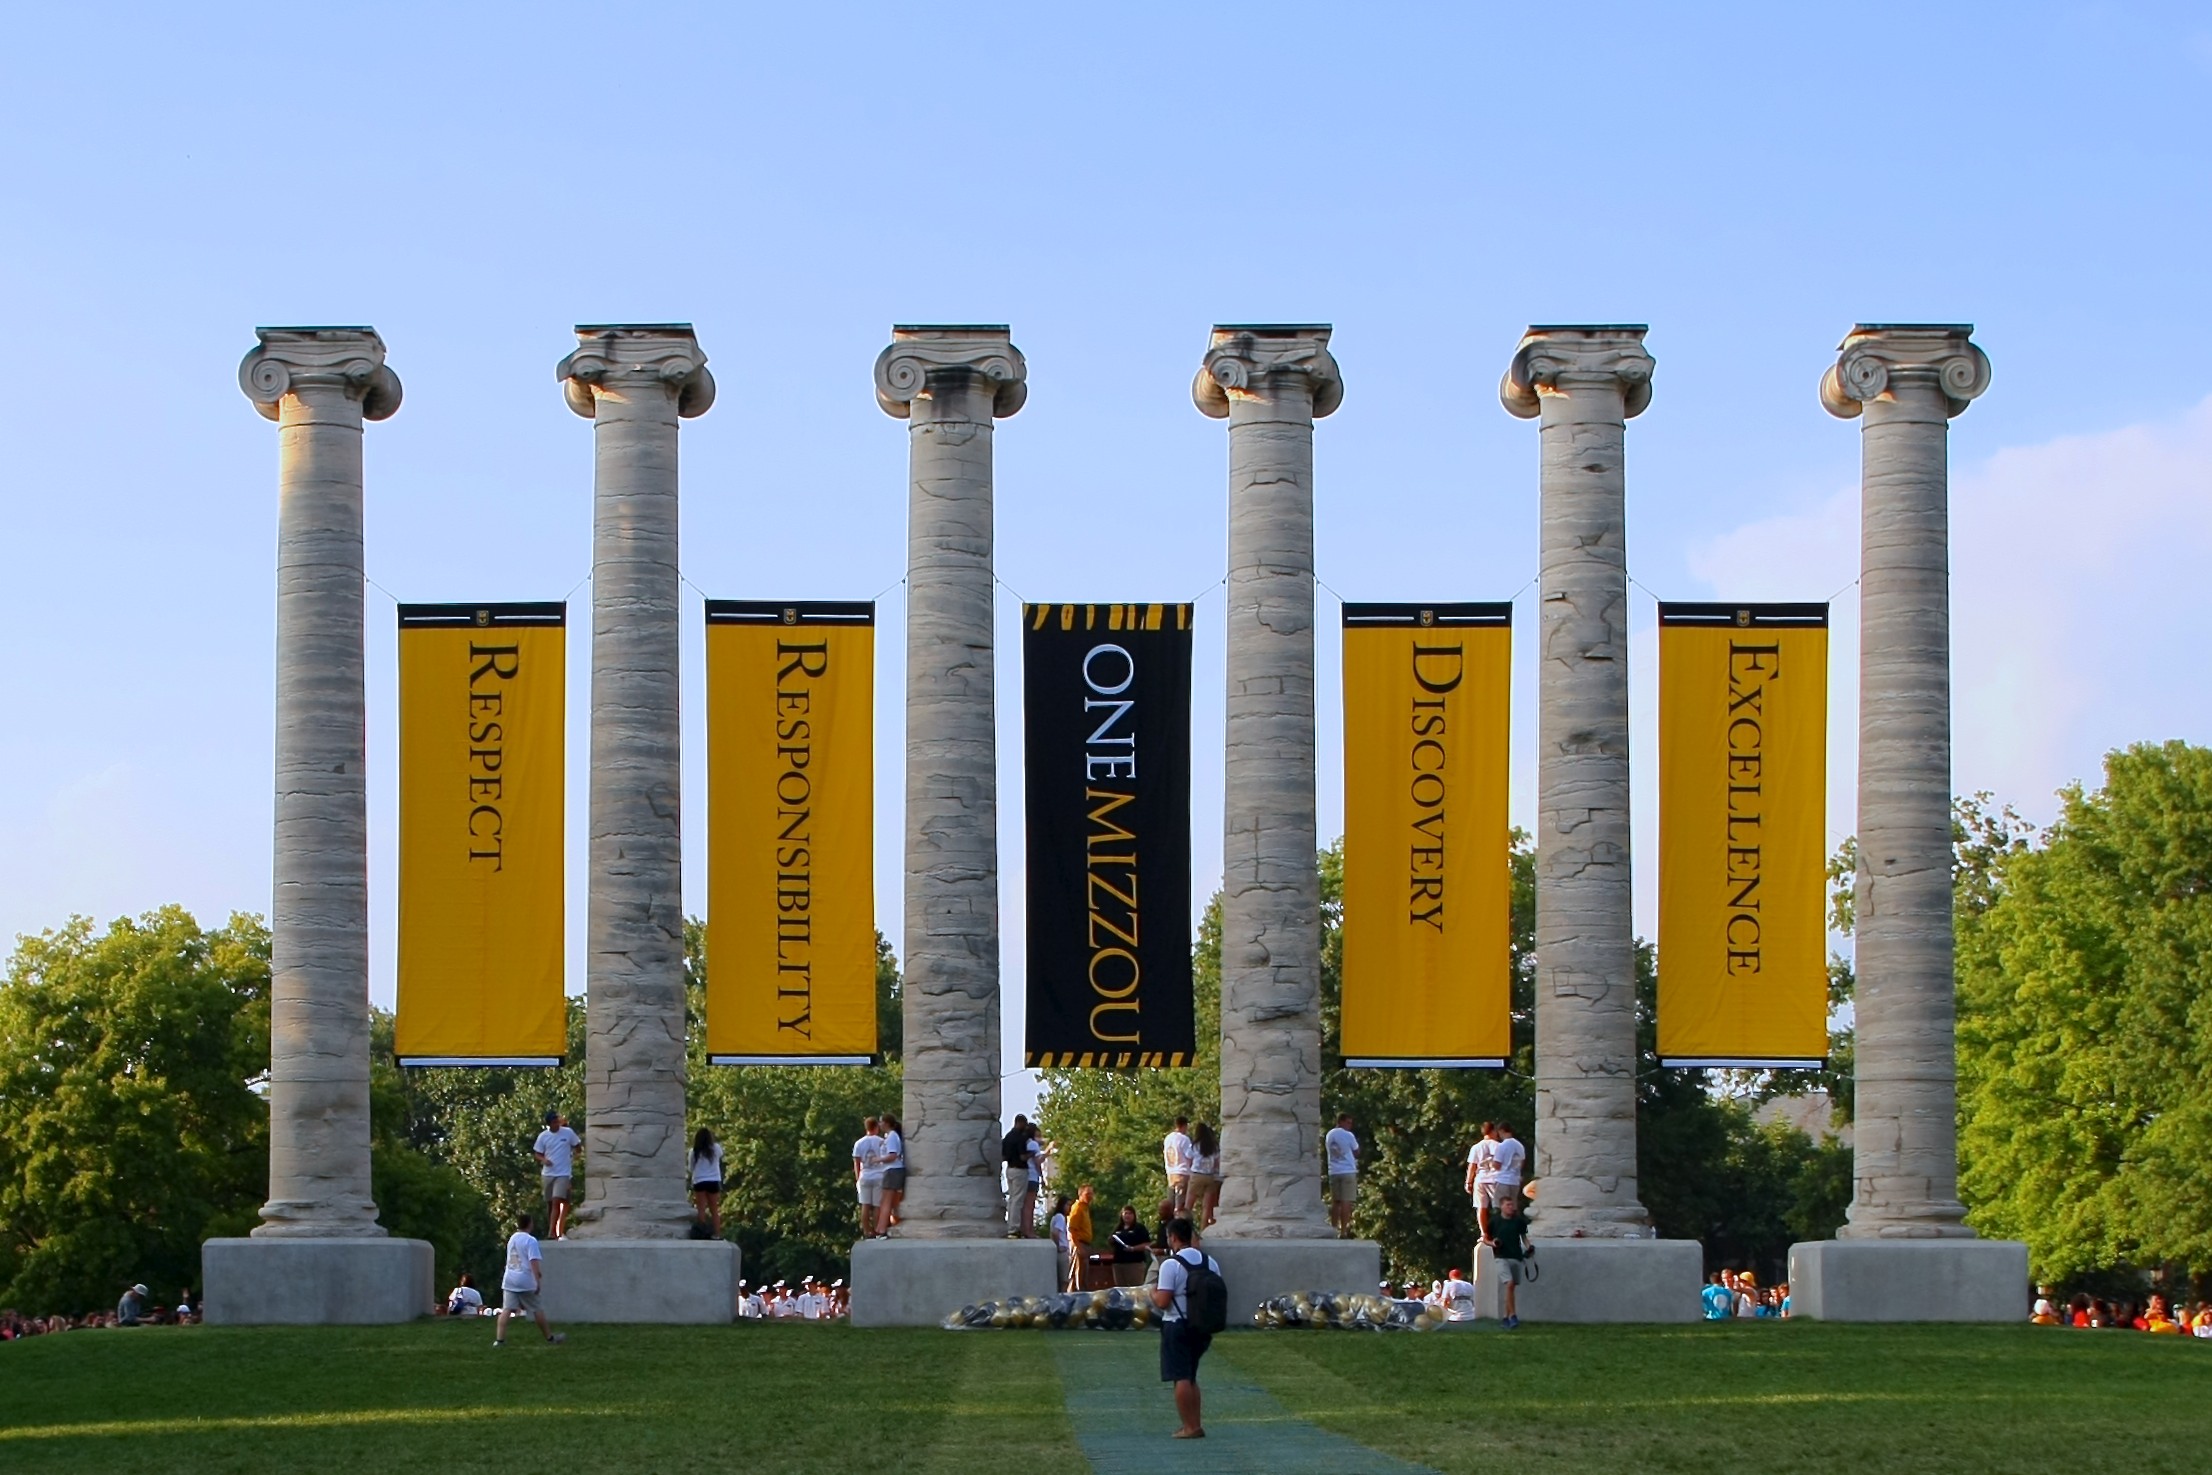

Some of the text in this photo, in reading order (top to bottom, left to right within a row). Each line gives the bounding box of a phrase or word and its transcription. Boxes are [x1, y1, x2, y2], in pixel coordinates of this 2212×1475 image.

[468, 640, 519, 873] RESPECT
[776, 638, 828, 1041] RESPONSIBILITY
[1409, 641, 1464, 934] DISCOVERY
[1726, 639, 1780, 977] EXCELLENCE
